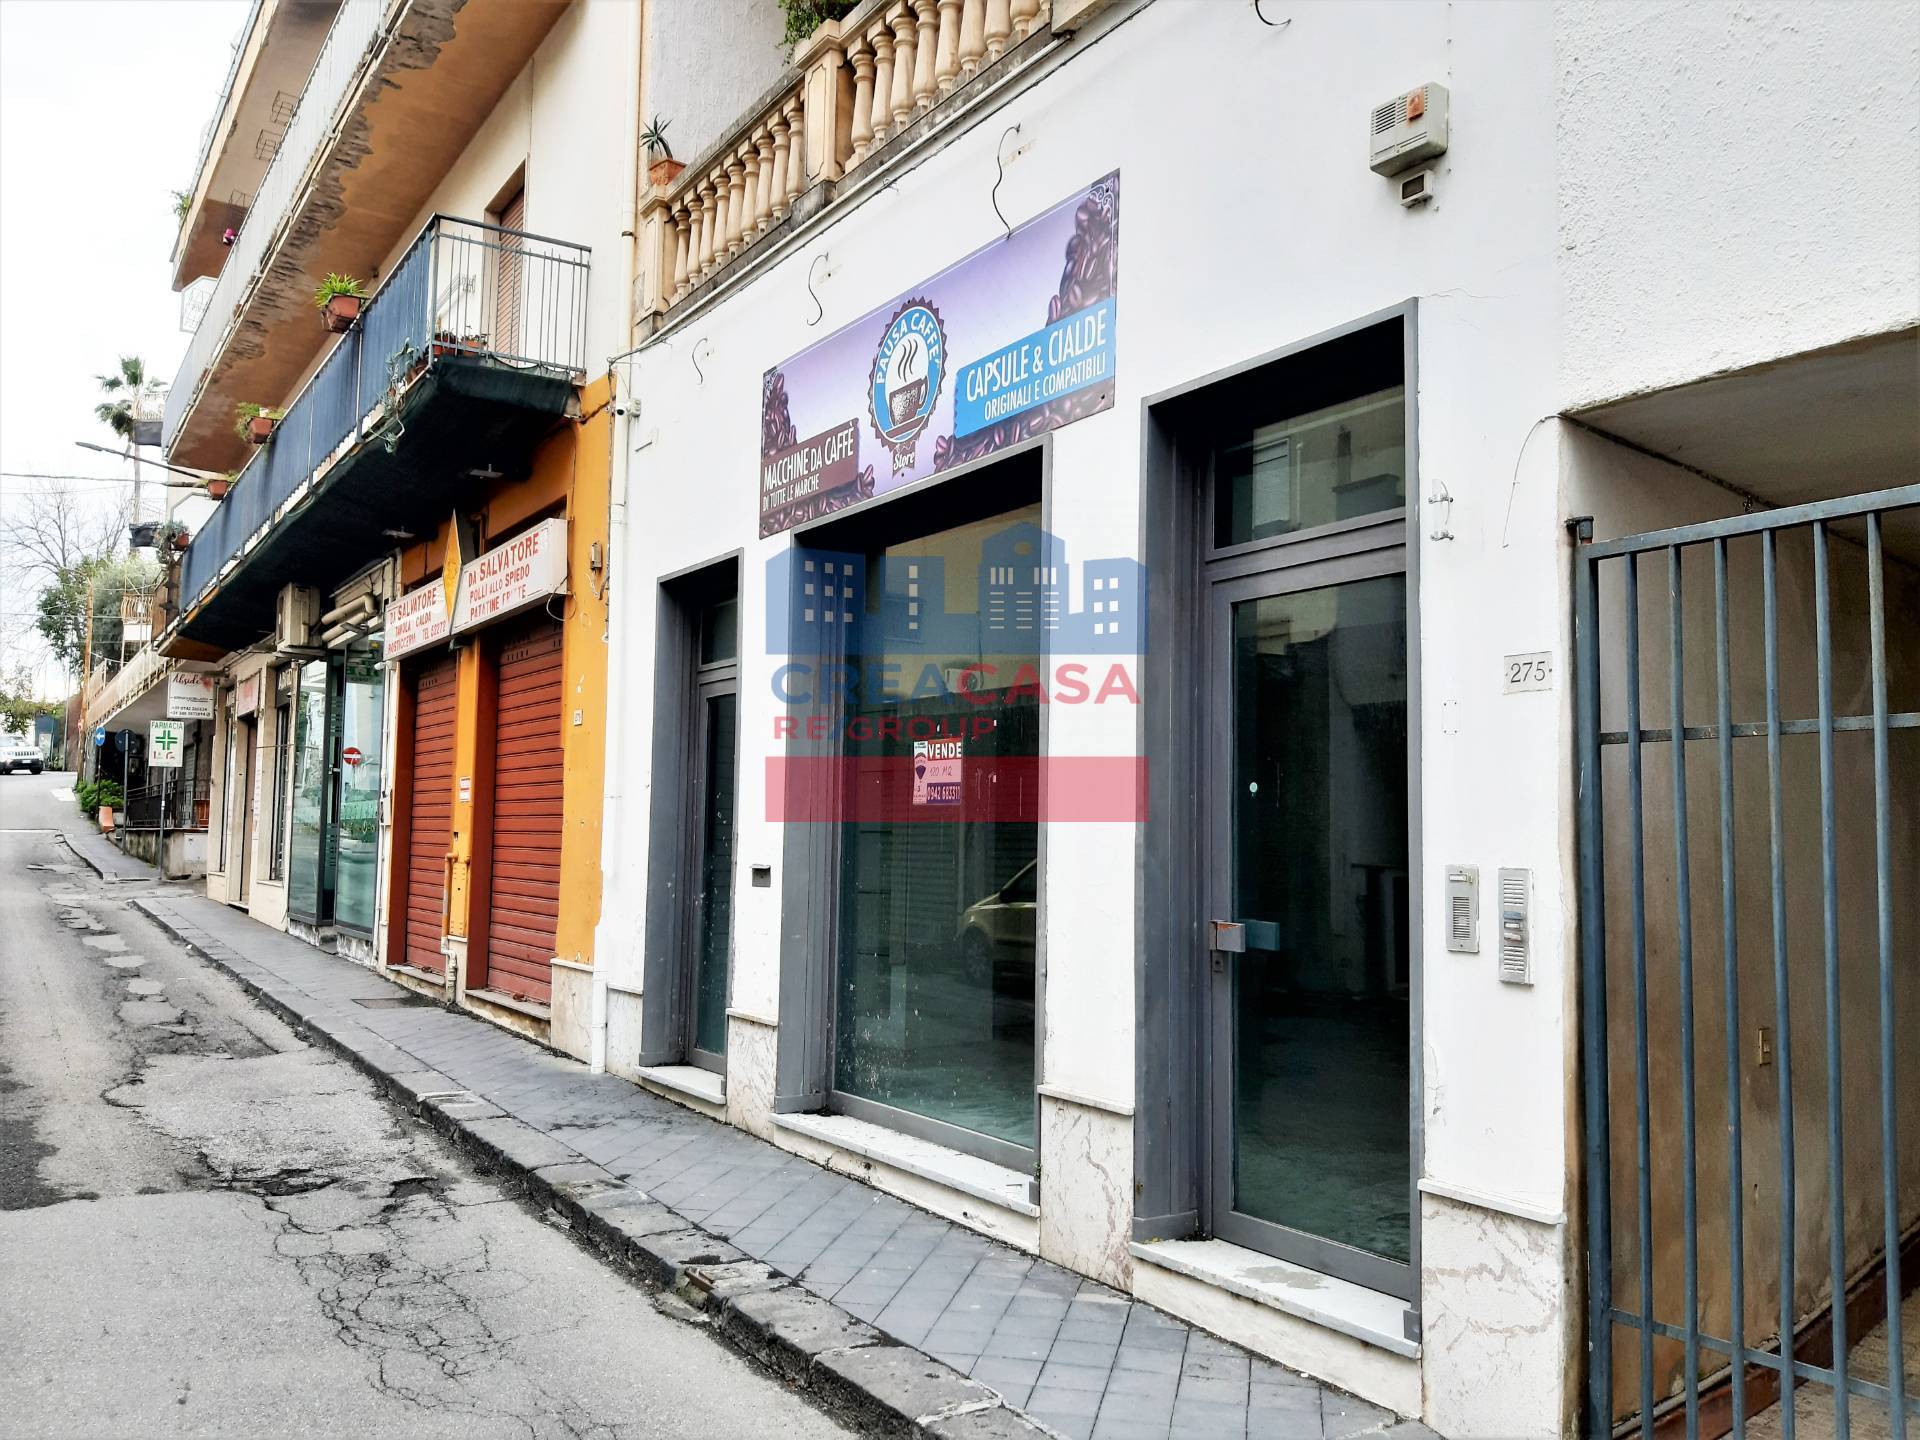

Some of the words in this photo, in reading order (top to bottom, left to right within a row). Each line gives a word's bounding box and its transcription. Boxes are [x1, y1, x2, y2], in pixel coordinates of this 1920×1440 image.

[876, 319, 908, 384] PAUSA
[966, 344, 1029, 402] CAPSULE
[1032, 346, 1044, 374] &
[1048, 308, 1107, 366] CIALDE
[984, 384, 1031, 421] ORIGINALI
[1034, 380, 1040, 400] E
[1042, 352, 1106, 397] COMPATIBILI
[763, 447, 809, 493] MACCHINE
[810, 445, 823, 472] DA
[824, 421, 854, 466] CAFFÈ
[770, 487, 786, 509] TUTTE
[786, 484, 794, 502] LE
[794, 473, 820, 499] MARCHE
[468, 571, 477, 588] DA
[479, 532, 539, 582] SALVATORE
[469, 583, 488, 605] POLLI
[505, 563, 530, 588] SPIEDO
[397, 587, 437, 621] SALVATORE
[470, 595, 500, 621] PATATINE
[1510, 660, 1546, 684] 275
[151, 721, 183, 730] FARMACIA
[928, 741, 962, 760] VENDE
